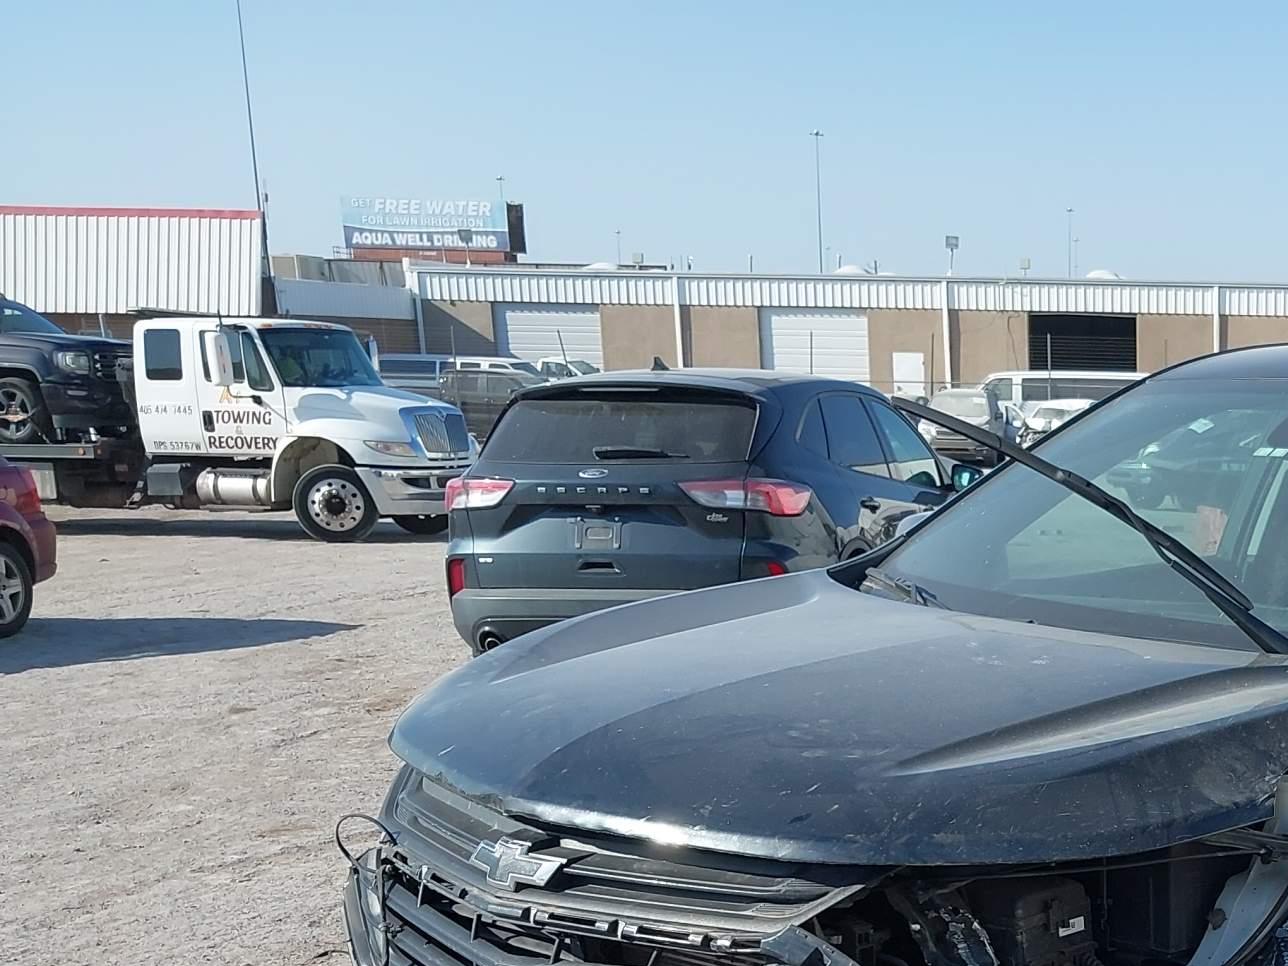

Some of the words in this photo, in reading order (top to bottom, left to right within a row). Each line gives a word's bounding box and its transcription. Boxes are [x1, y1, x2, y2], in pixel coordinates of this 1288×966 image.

[351, 198, 371, 208] GET
[374, 199, 422, 215] FREE
[426, 200, 492, 217] WATER
[361, 215, 383, 225] FOR
[386, 215, 418, 226] LAWN
[421, 216, 484, 227] IRRIGATION
[351, 231, 393, 246] AQUA
[394, 233, 432, 246] WELL
[214, 410, 272, 425] TOWING
[208, 436, 279, 450] RECOVERY
